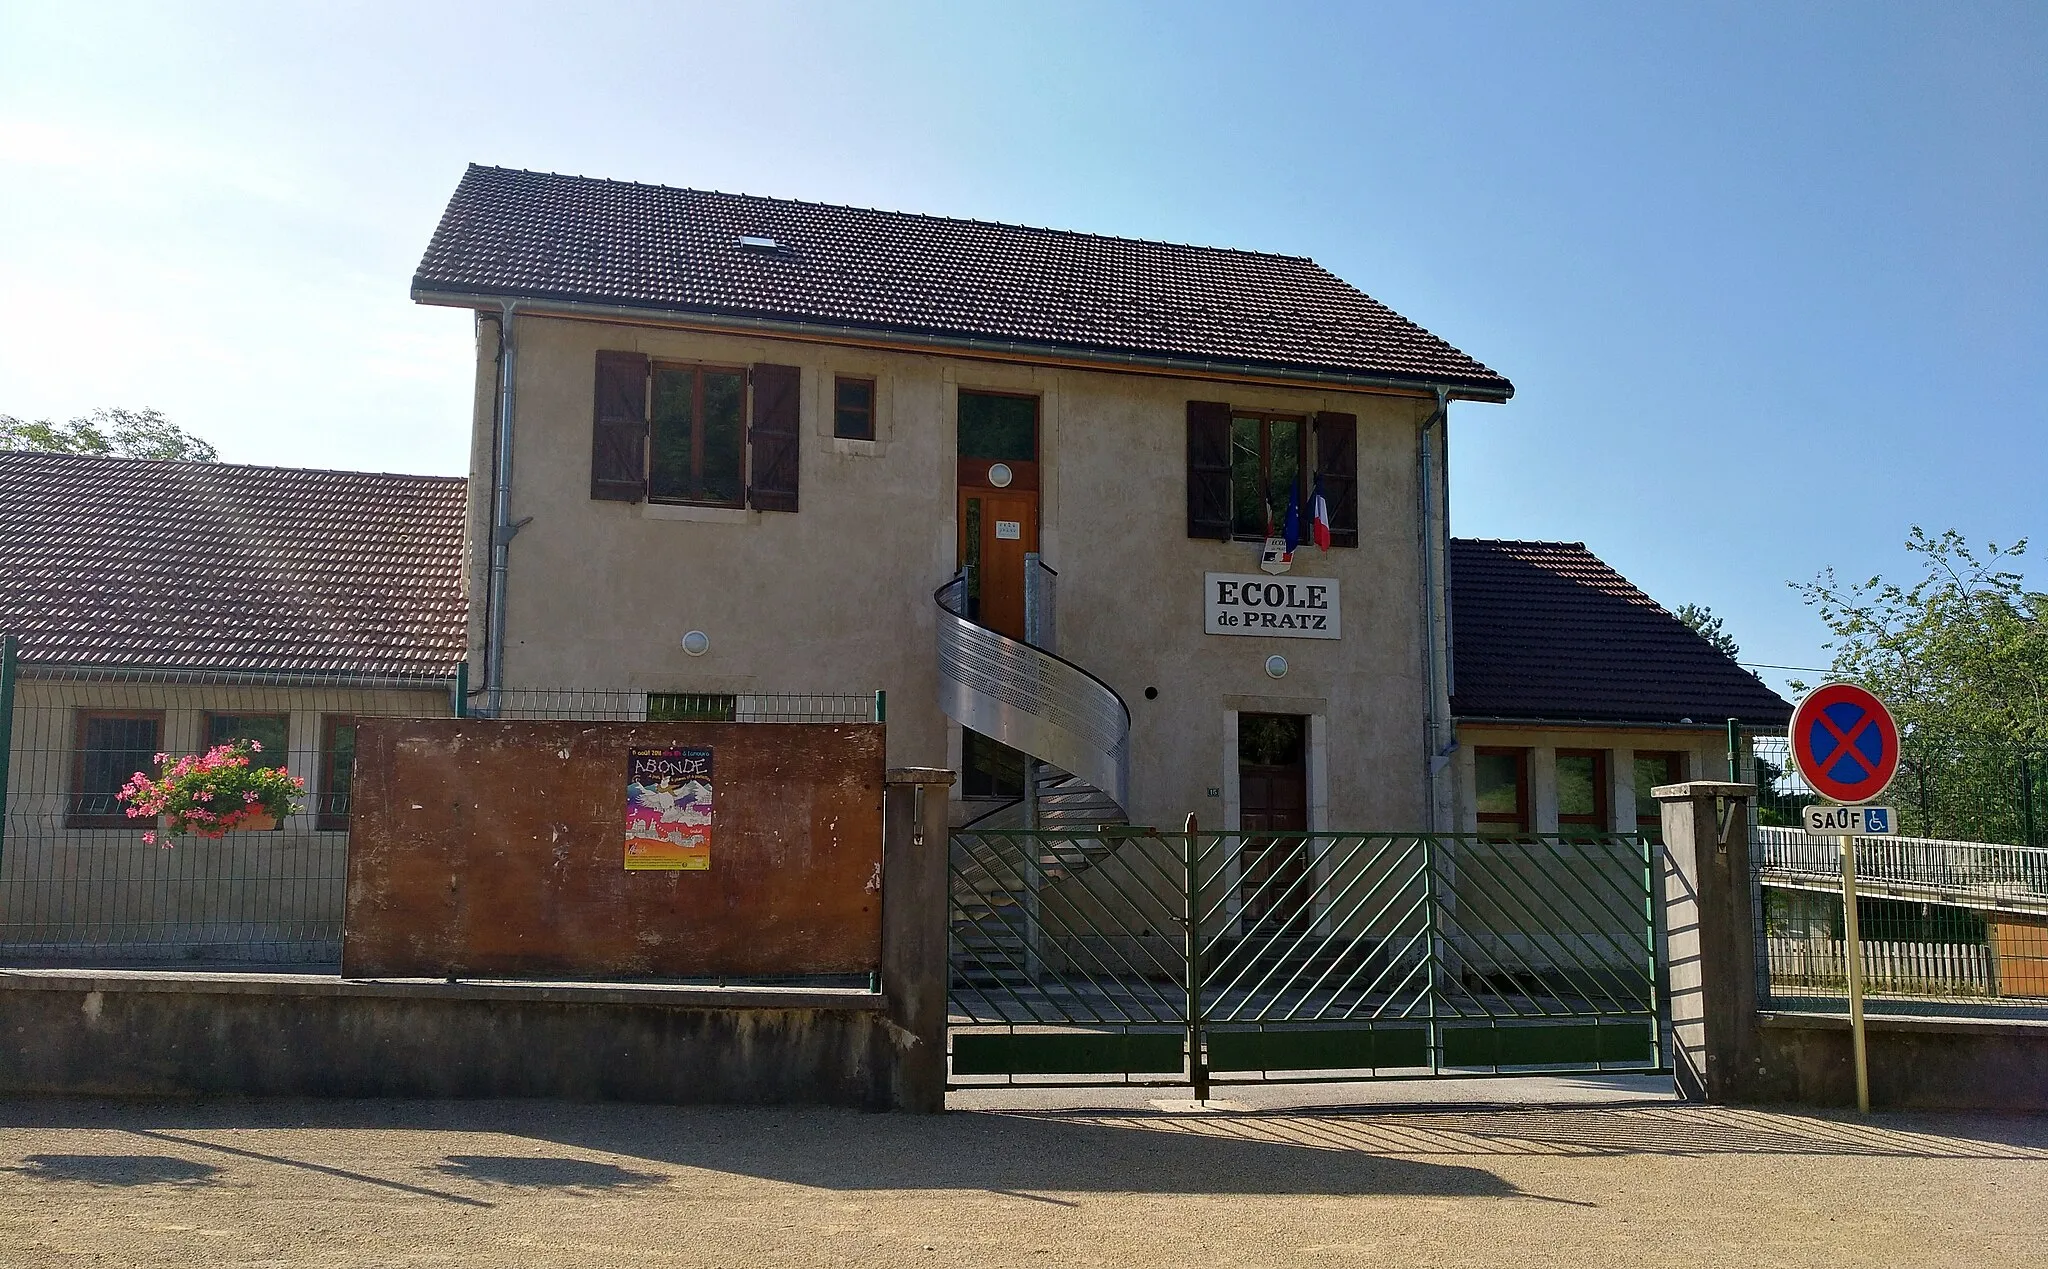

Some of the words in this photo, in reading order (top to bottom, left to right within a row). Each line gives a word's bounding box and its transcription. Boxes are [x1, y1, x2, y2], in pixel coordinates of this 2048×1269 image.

[1217, 581, 1328, 610] ECOLE
[1217, 611, 1239, 627] de
[1243, 612, 1327, 630] PRATZ
[634, 758, 708, 775] ABONDE
[1811, 811, 1861, 829] SAUF
